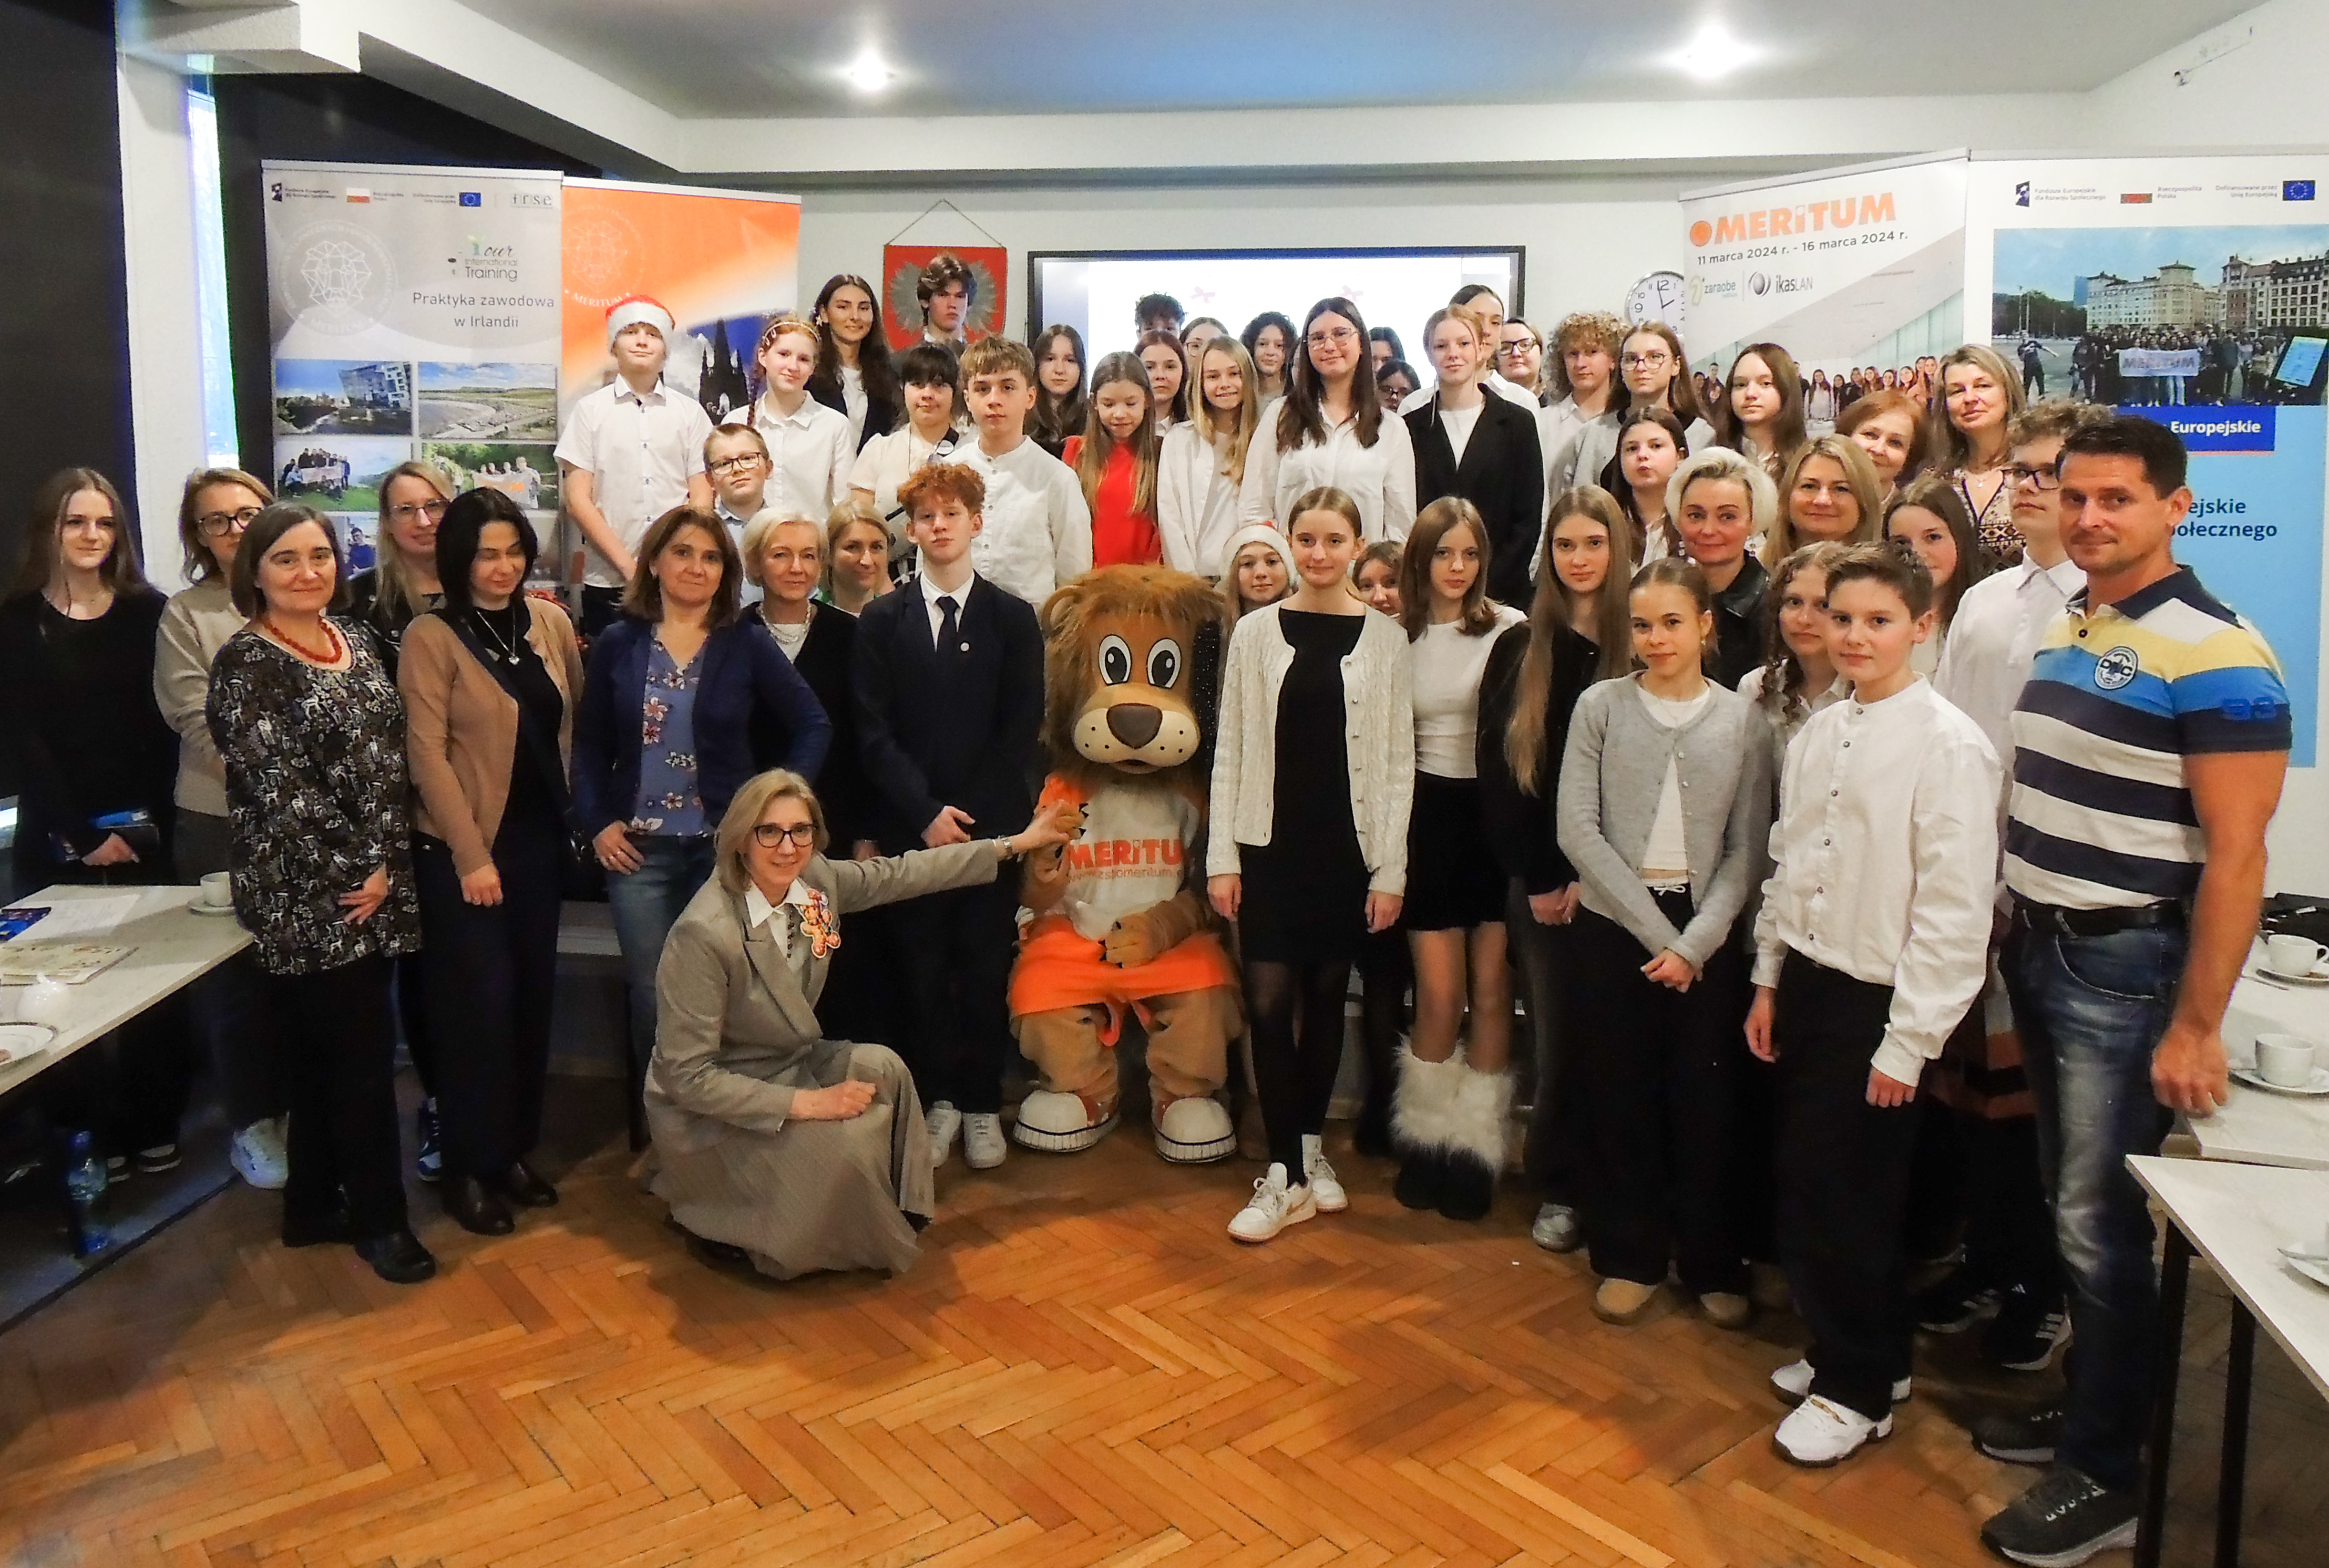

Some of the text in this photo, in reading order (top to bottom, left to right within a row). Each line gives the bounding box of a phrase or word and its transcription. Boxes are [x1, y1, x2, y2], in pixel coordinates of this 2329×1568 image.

[512, 193, 551, 205] frse
[1697, 255, 1706, 265] 11
[1709, 252, 1743, 263] marca
[1747, 245, 1778, 259] 2024
[1781, 246, 1790, 254] r.
[1802, 241, 1815, 252] 16
[1819, 238, 1857, 250] marca
[1861, 231, 1894, 245] 2024
[1899, 231, 1908, 240] r.
[465, 266, 518, 282] Training
[1657, 279, 1670, 291] 12
[1704, 279, 1736, 294] zaraobe
[413, 292, 555, 308] Praktyka zawodowa
[571, 292, 623, 307] MERITUM
[1634, 303, 1643, 313] 9
[454, 316, 518, 327] w Irlandii
[2170, 420, 2262, 437] Europejskie
